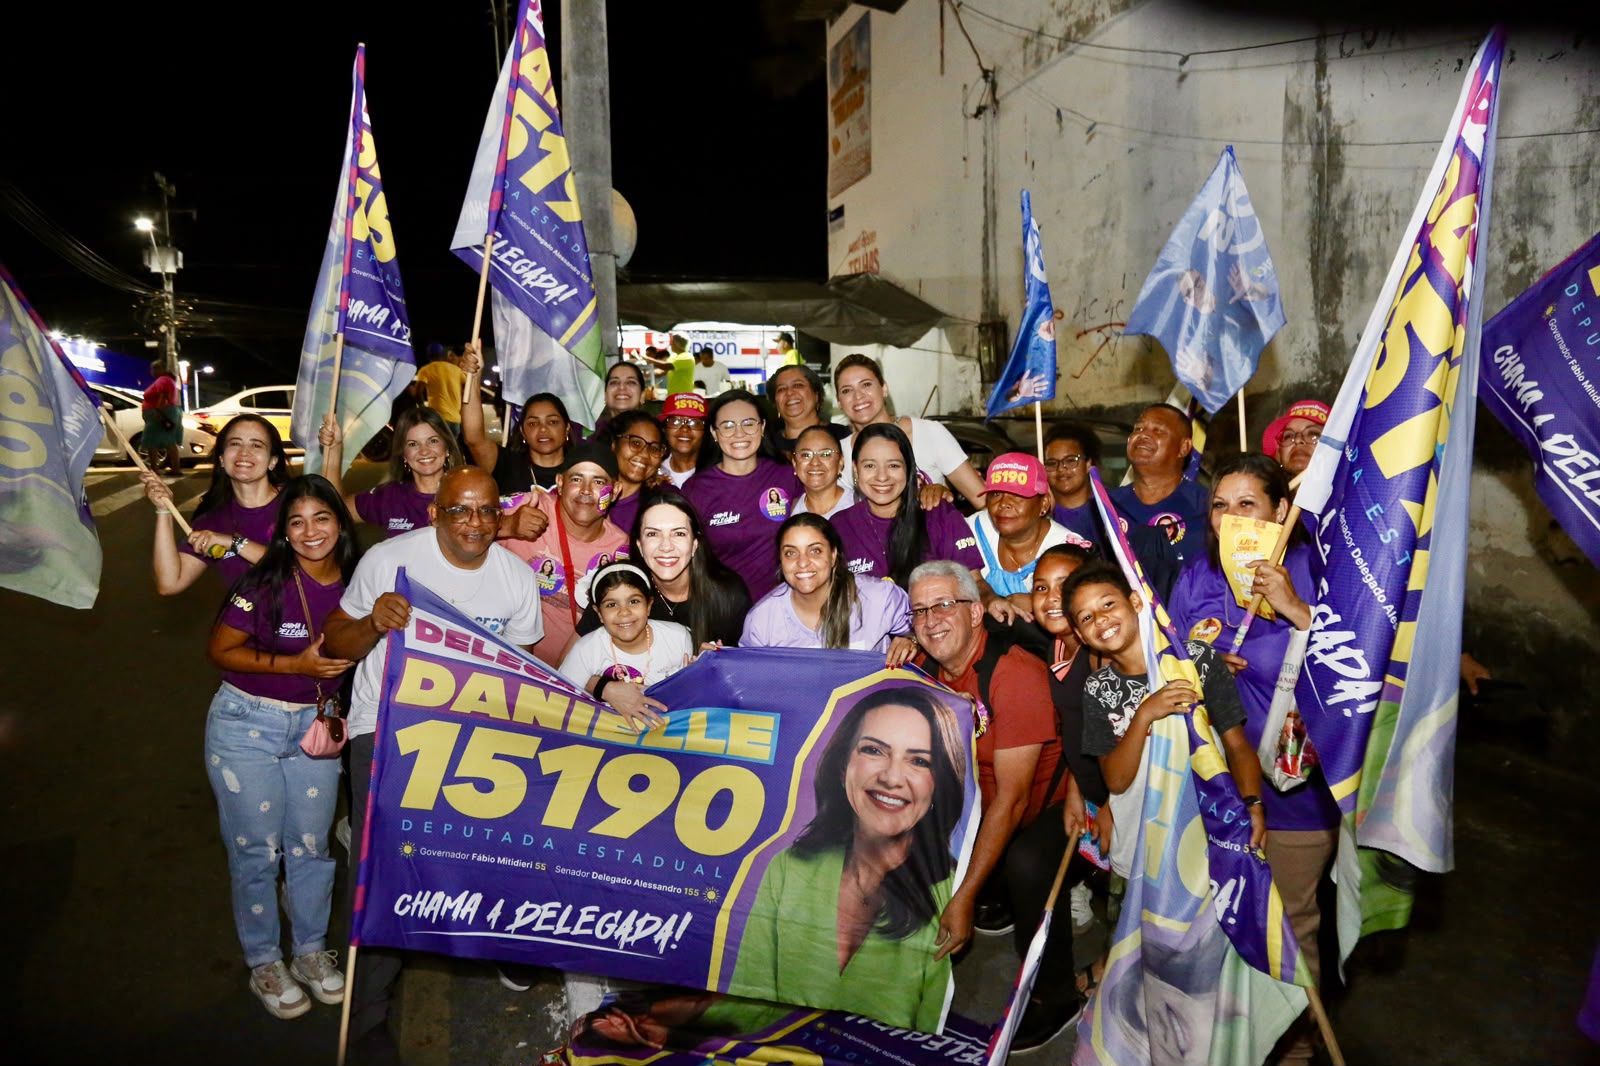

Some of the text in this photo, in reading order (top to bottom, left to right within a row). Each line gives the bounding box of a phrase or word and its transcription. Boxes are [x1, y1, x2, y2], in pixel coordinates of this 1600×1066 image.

[1493, 344, 1544, 413] CHAMA
[1548, 318, 1573, 360] Governador
[1568, 358, 1585, 382] Fábio
[674, 399, 705, 413] 15190
[991, 470, 1028, 486] 15190
[1350, 547, 1387, 604] Delegado
[395, 719, 767, 856] 15190
[401, 819, 722, 878] DEPUTADA ESTADUAL
[419, 847, 700, 897] Governador Fábio Mitidieri 55 Senador Delegado Alessandro 155
[393, 890, 694, 955] CHAMA A DELEGADA!
